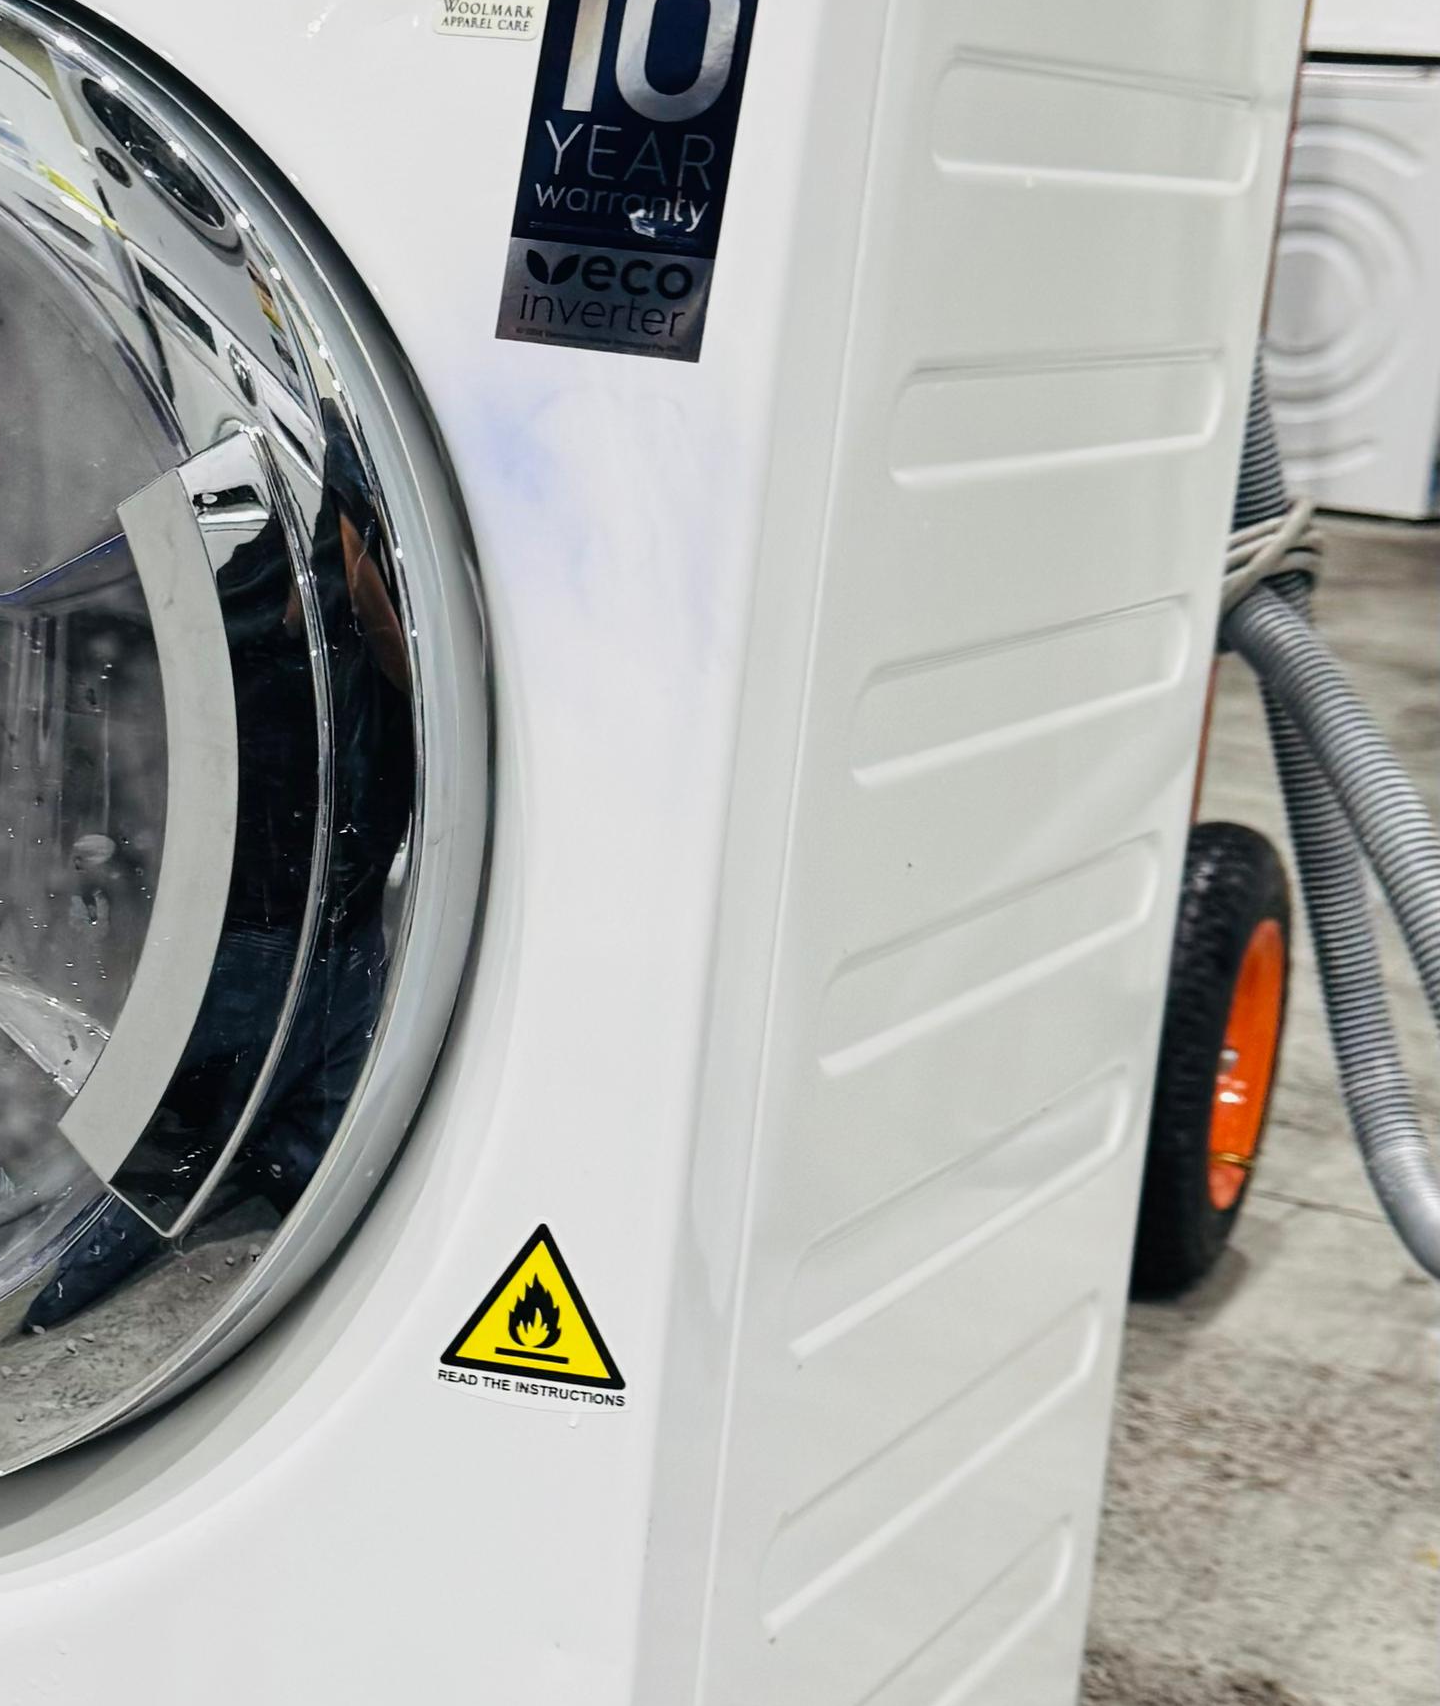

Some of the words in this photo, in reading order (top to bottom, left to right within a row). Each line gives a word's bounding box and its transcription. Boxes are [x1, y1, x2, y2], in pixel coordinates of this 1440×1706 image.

[441, 16, 492, 29] APPAREL
[498, 19, 529, 32] CARE
[545, 119, 716, 191] YEAR
[535, 182, 709, 233] warranty
[582, 252, 693, 301] eco
[519, 286, 687, 338] inverter
[438, 1369, 478, 1386] READ
[482, 1376, 511, 1391] THE
[515, 1381, 625, 1407] INSTRUCTIONS
